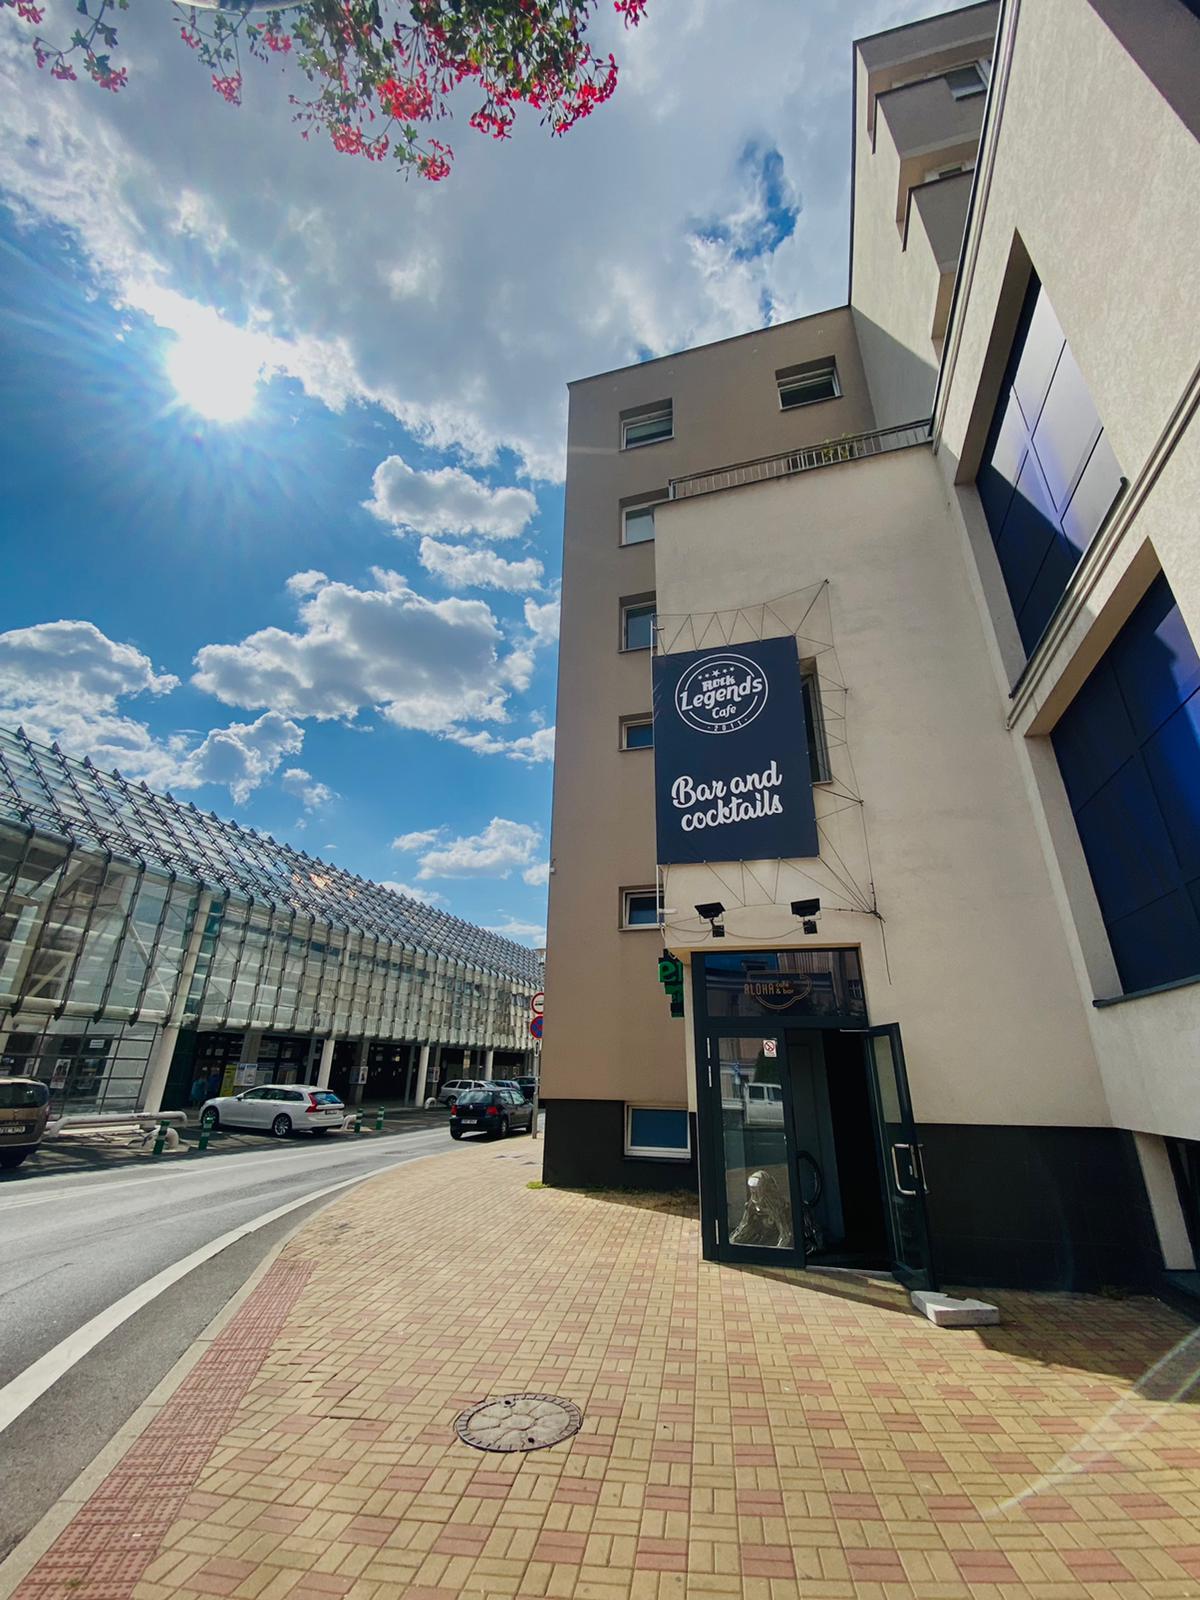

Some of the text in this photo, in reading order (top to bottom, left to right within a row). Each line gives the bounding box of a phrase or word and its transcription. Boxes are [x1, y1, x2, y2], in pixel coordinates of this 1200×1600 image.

[680, 675, 763, 711] Legends
[712, 704, 737, 719] Cafe
[671, 760, 783, 809] Bar and
[681, 790, 784, 832] cocktails
[743, 983, 775, 995] ALOHA
